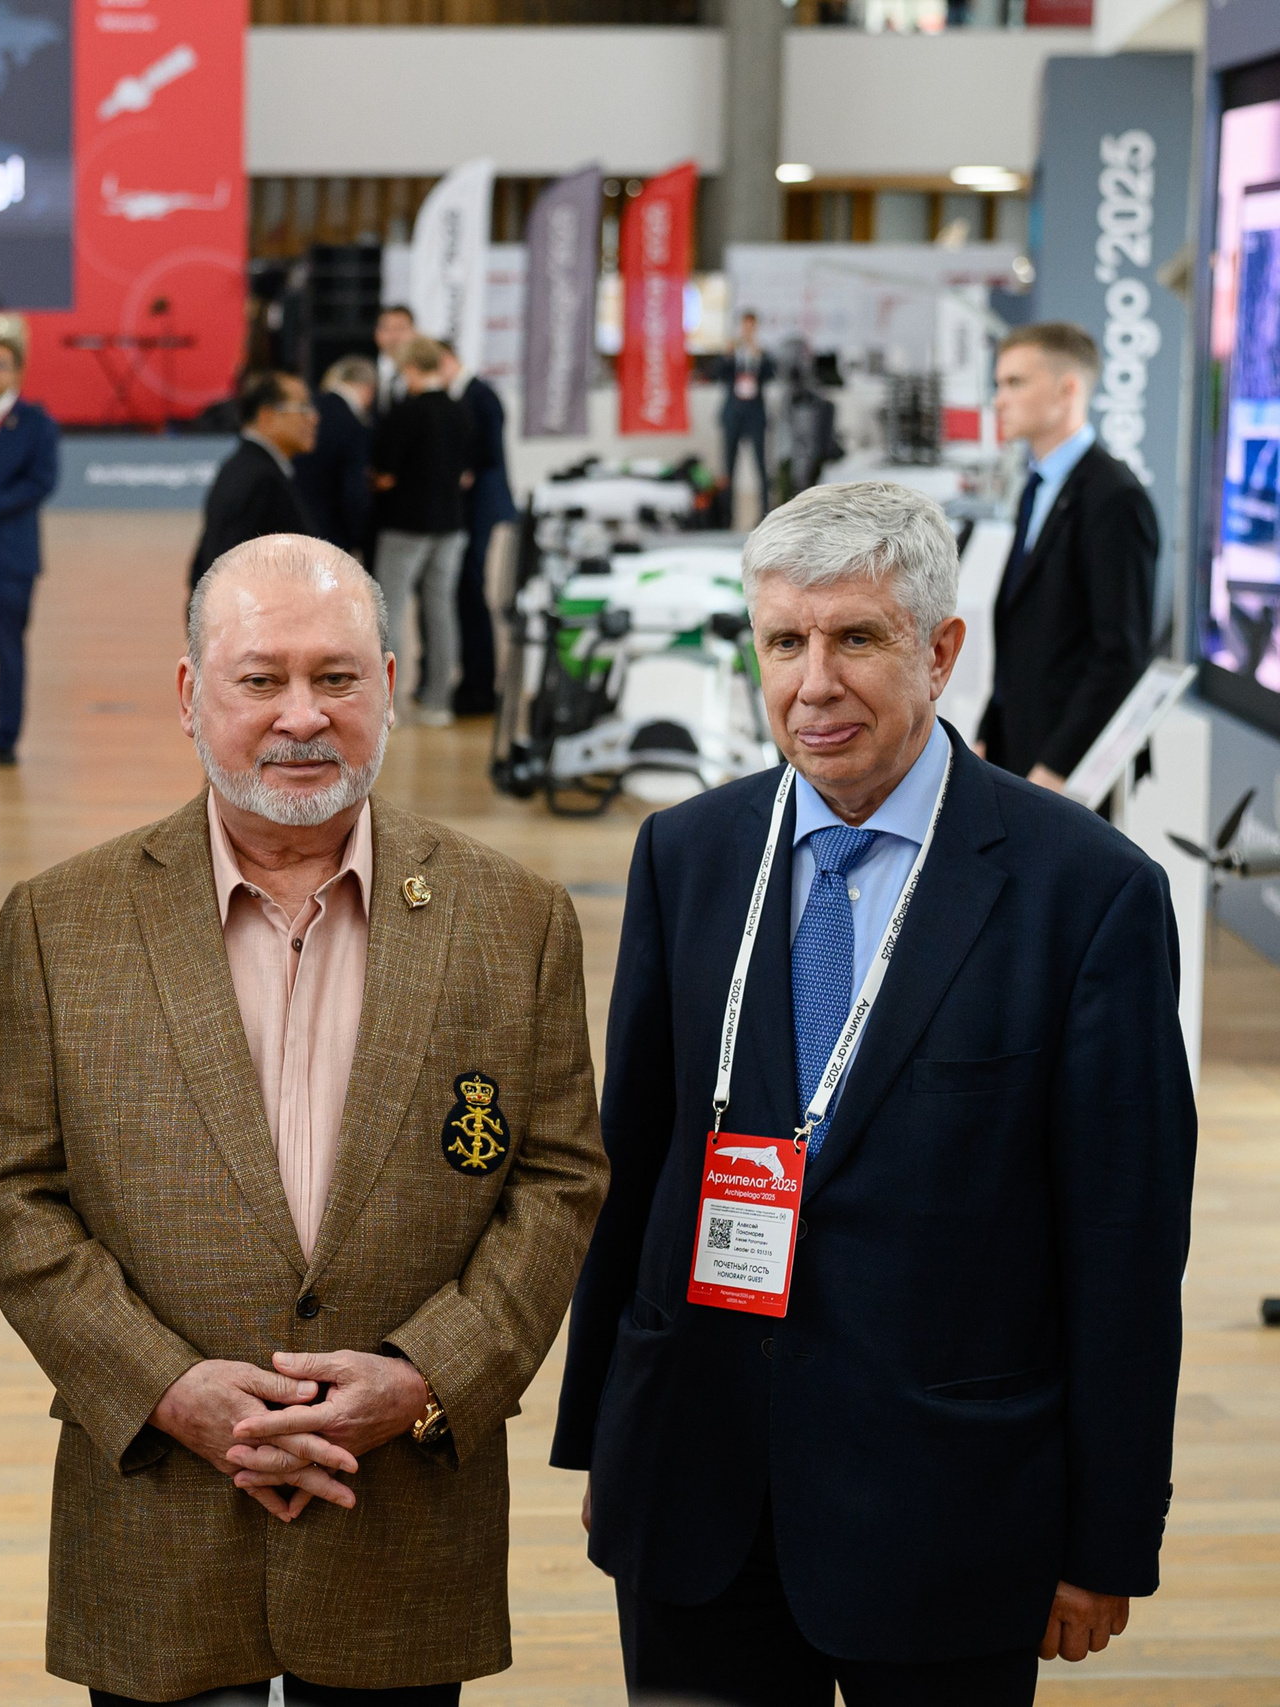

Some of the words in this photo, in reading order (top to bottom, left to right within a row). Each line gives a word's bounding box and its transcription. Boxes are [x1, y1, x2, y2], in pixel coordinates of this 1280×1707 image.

[721, 978, 742, 1072] Архипелаг'2025
[824, 998, 870, 1089] Архипелаг'2025
[706, 1169, 797, 1192] Архипелаг'2025
[713, 1259, 748, 1271] ПОЧЕТНЫЙ
[749, 1264, 770, 1275] ГОСТЬ
[717, 1271, 747, 1281] HONORARY
[747, 1275, 764, 1283] GUEST
